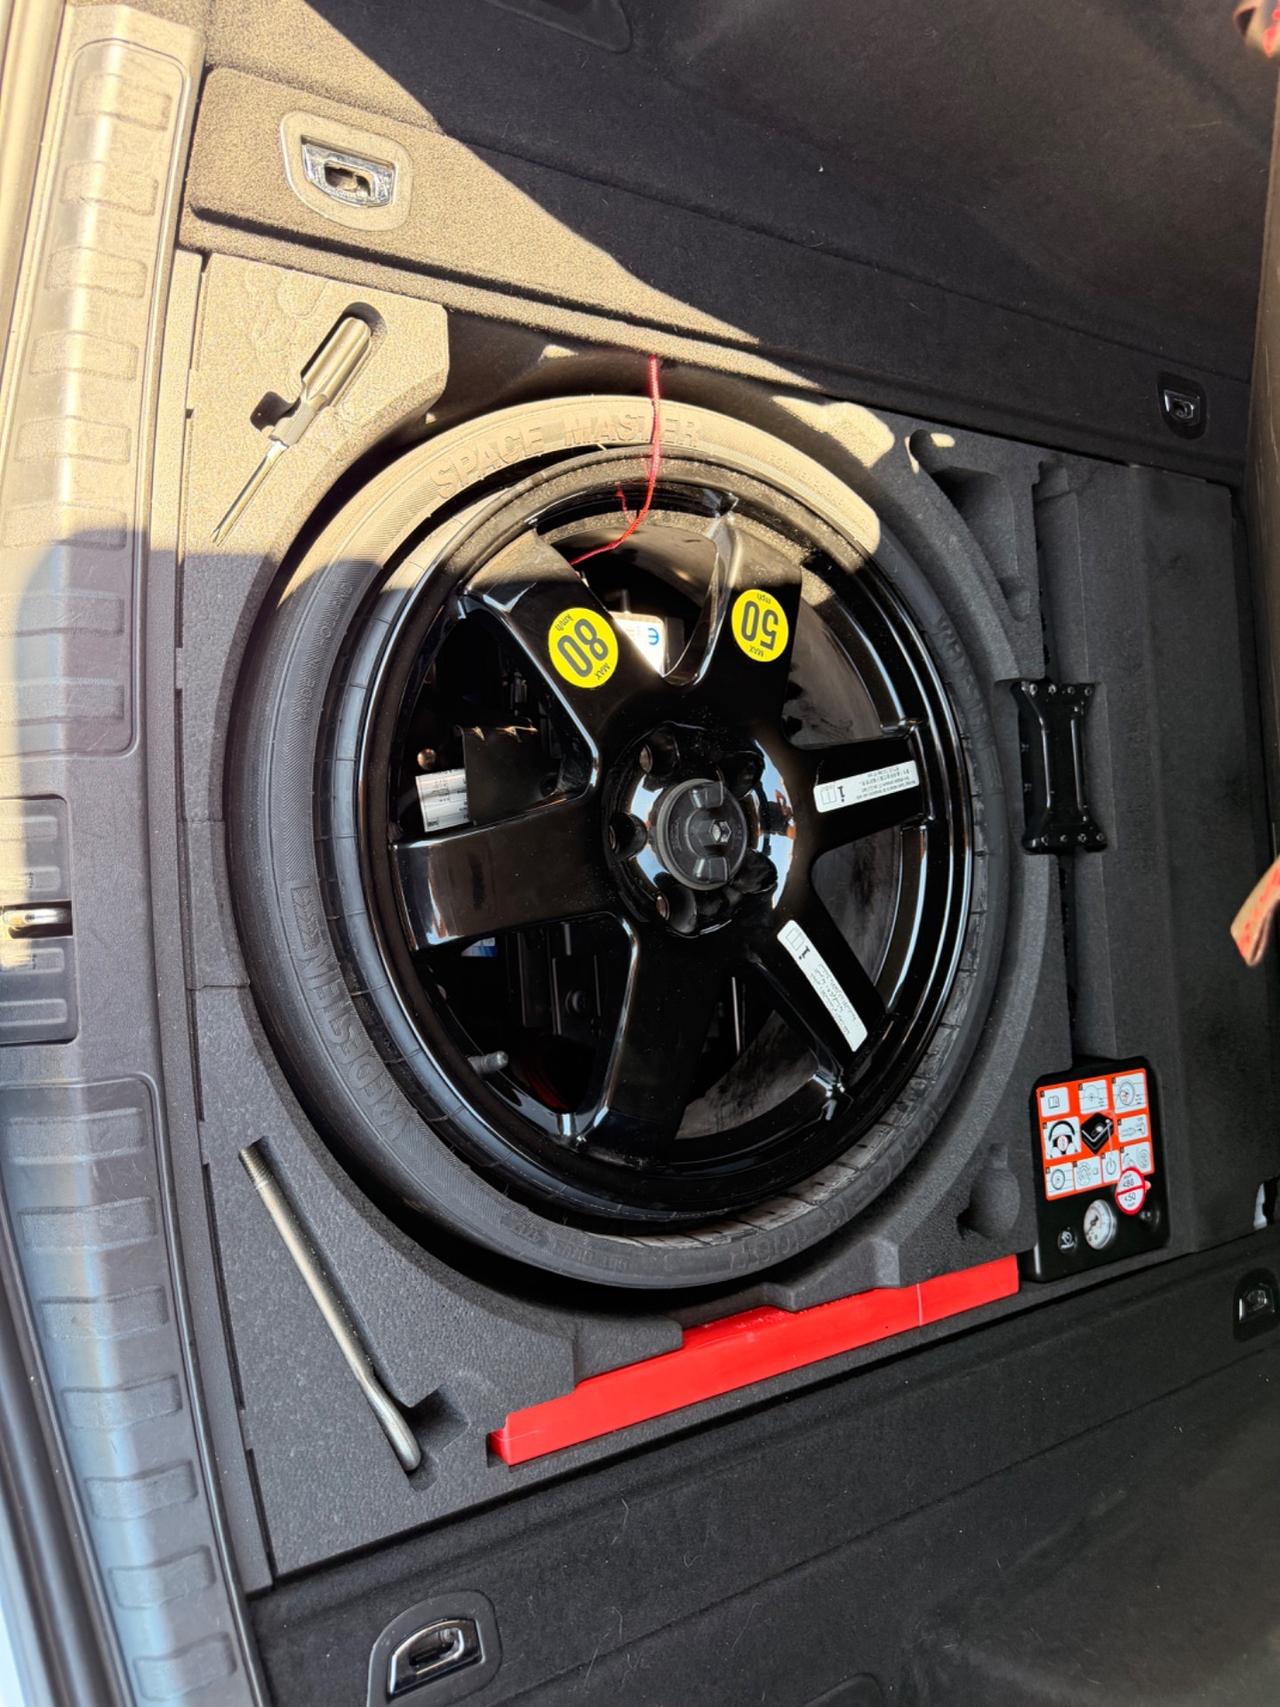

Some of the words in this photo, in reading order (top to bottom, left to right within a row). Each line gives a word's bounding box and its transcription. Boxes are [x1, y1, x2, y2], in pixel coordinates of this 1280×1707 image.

[429, 425, 545, 501] SPACE
[562, 412, 700, 449] MASTER
[557, 618, 609, 677] 80
[741, 601, 779, 651] 50
[749, 644, 765, 658] MAX
[593, 661, 611, 680] MAX
